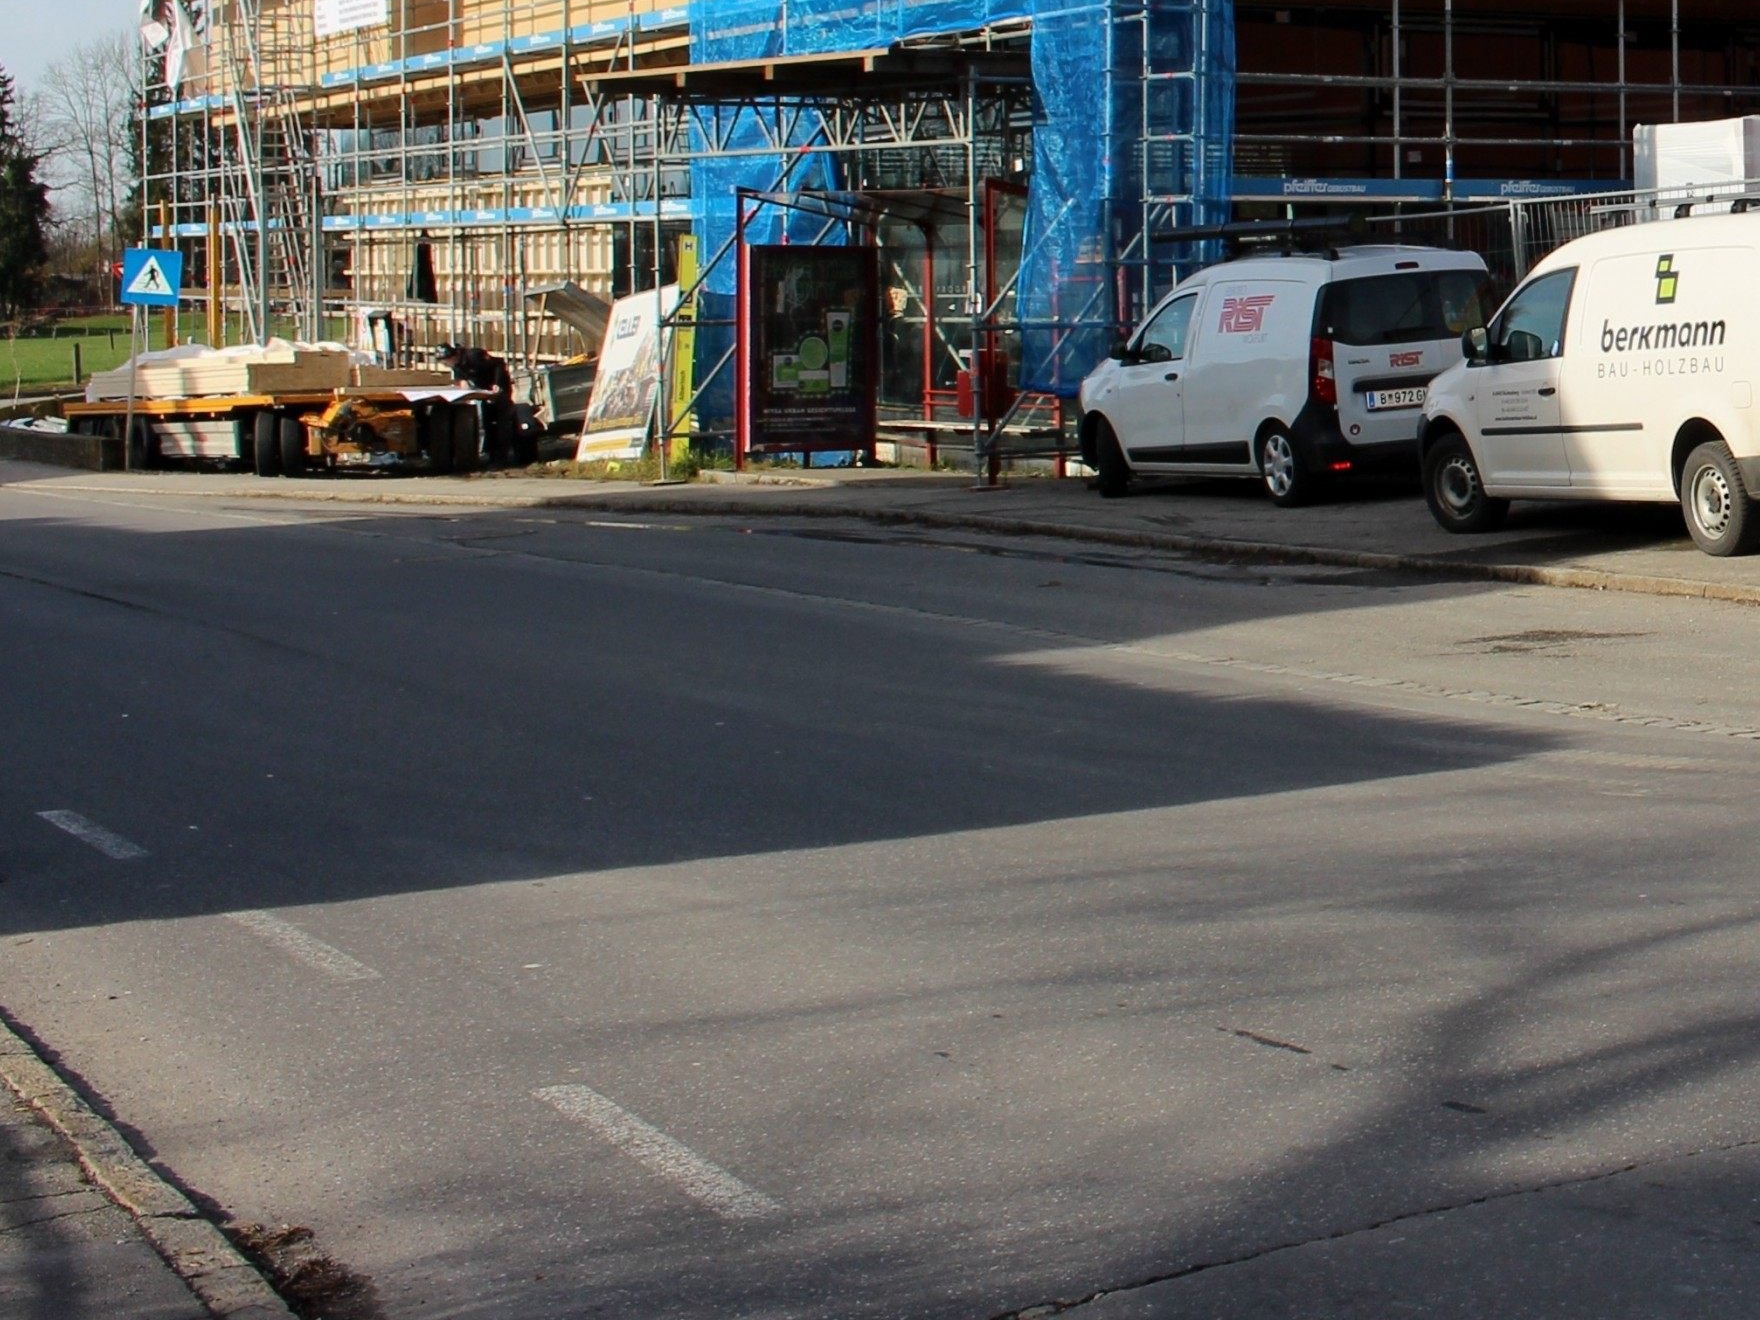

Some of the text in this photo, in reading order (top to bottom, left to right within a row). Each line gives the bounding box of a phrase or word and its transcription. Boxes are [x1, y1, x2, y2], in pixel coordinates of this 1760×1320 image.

[1500, 180, 1540, 195] pfeiffer
[1600, 318, 1727, 354] berkmann
[1395, 390, 1414, 404] 972
